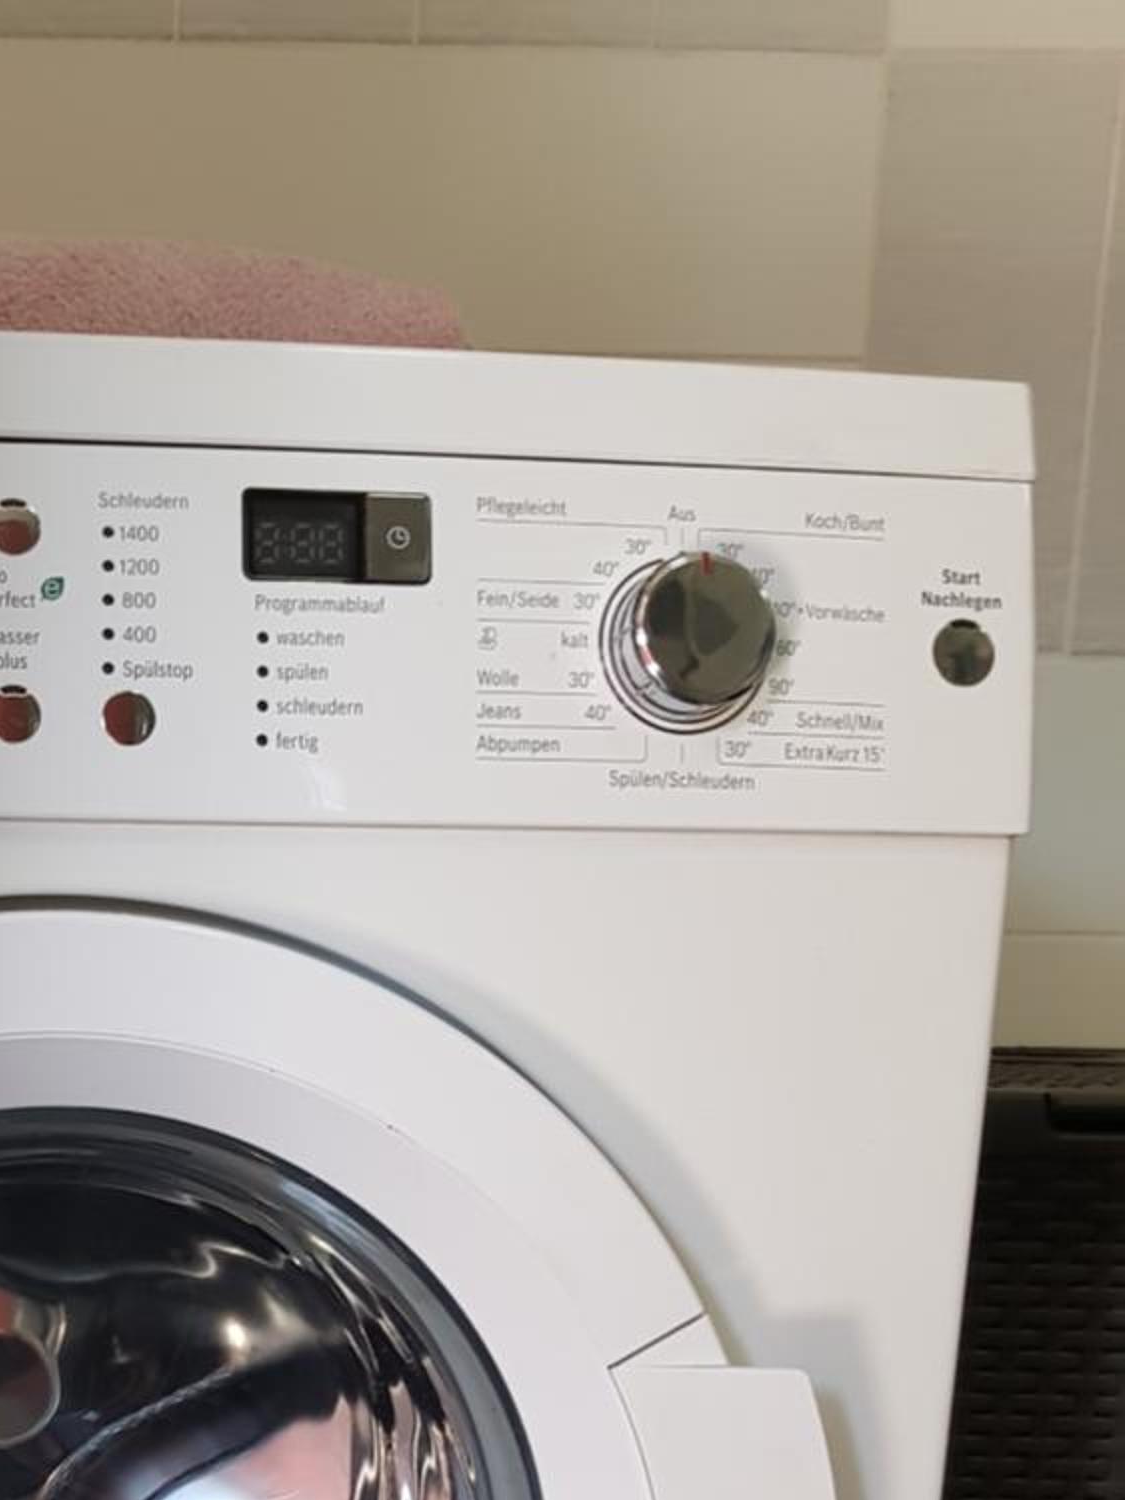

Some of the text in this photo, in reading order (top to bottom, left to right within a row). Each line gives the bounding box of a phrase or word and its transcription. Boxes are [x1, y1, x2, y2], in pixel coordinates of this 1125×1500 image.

[98, 491, 190, 510] Schleudern
[476, 496, 568, 518] Pflegeleicht
[668, 505, 696, 522] Aus
[805, 512, 885, 532] Koch/Bunt
[120, 525, 160, 542] 1400
[120, 558, 160, 576] 1200
[941, 568, 981, 586] Start
[122, 591, 157, 609] 800
[254, 594, 386, 617] Programmablauf
[476, 590, 559, 609] Fein/Seide
[920, 590, 1003, 612] Nachlegen
[122, 626, 157, 643] 400
[277, 630, 346, 647] waschen
[561, 630, 589, 648] kalt
[122, 660, 194, 681] Spülstop
[277, 661, 329, 683] spülen
[476, 669, 520, 687] Wolle
[277, 697, 364, 716] schleudern
[476, 703, 522, 720] Jeans
[795, 711, 884, 732] Schnell/Mix
[276, 731, 319, 754] fertig
[476, 735, 561, 755] Abpumpen
[609, 769, 756, 791] Spülen/Schleudern
